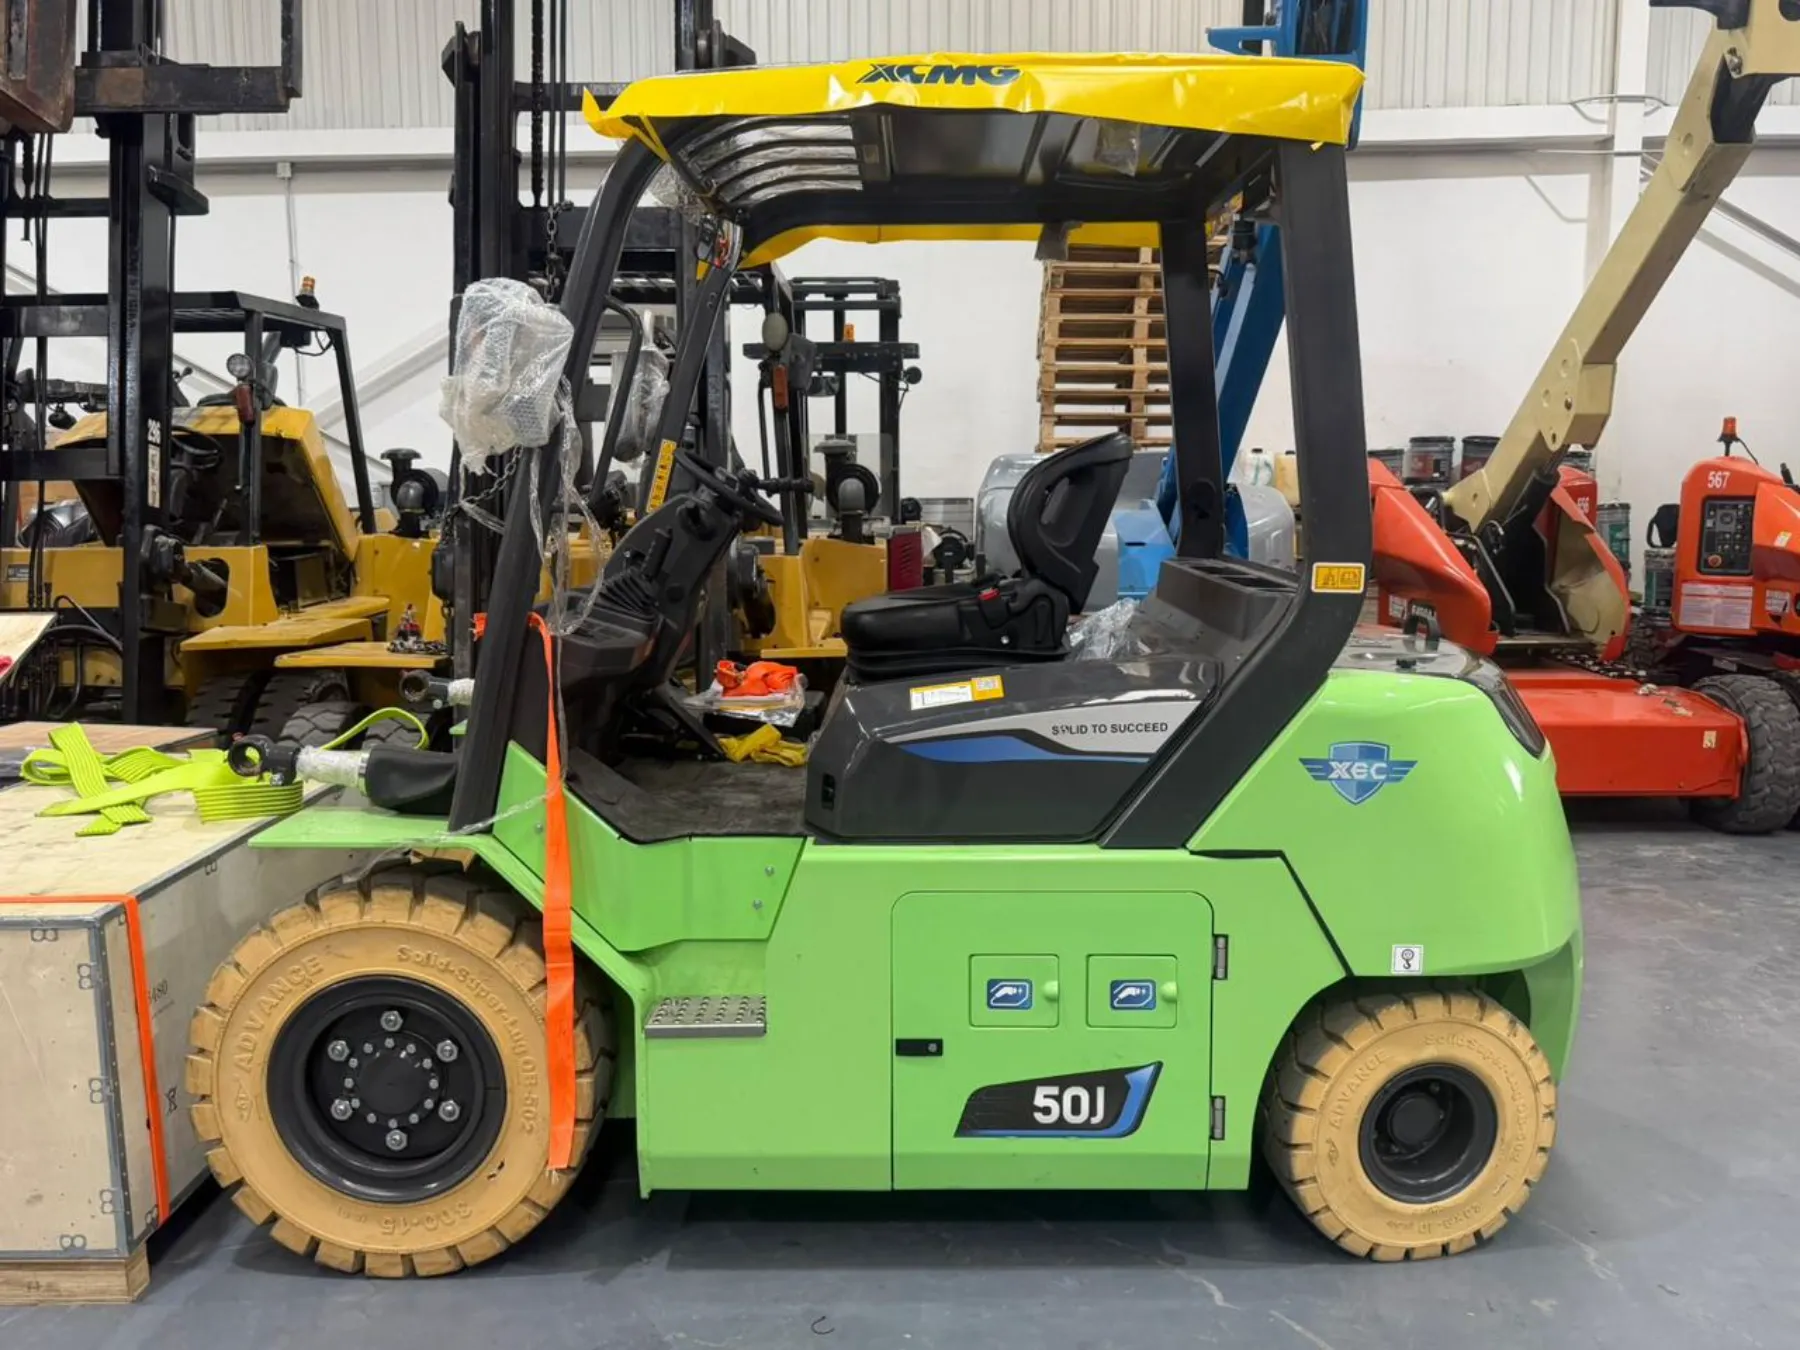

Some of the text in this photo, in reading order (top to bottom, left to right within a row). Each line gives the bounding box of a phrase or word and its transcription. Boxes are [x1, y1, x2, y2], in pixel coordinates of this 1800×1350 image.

[855, 64, 1021, 85] XCMG
[1707, 471, 1731, 488] 567
[1092, 723, 1107, 734] TO
[1110, 722, 1168, 733] SUCCEED
[235, 955, 324, 1073] ADVANCE
[1033, 1086, 1105, 1124] 50J
